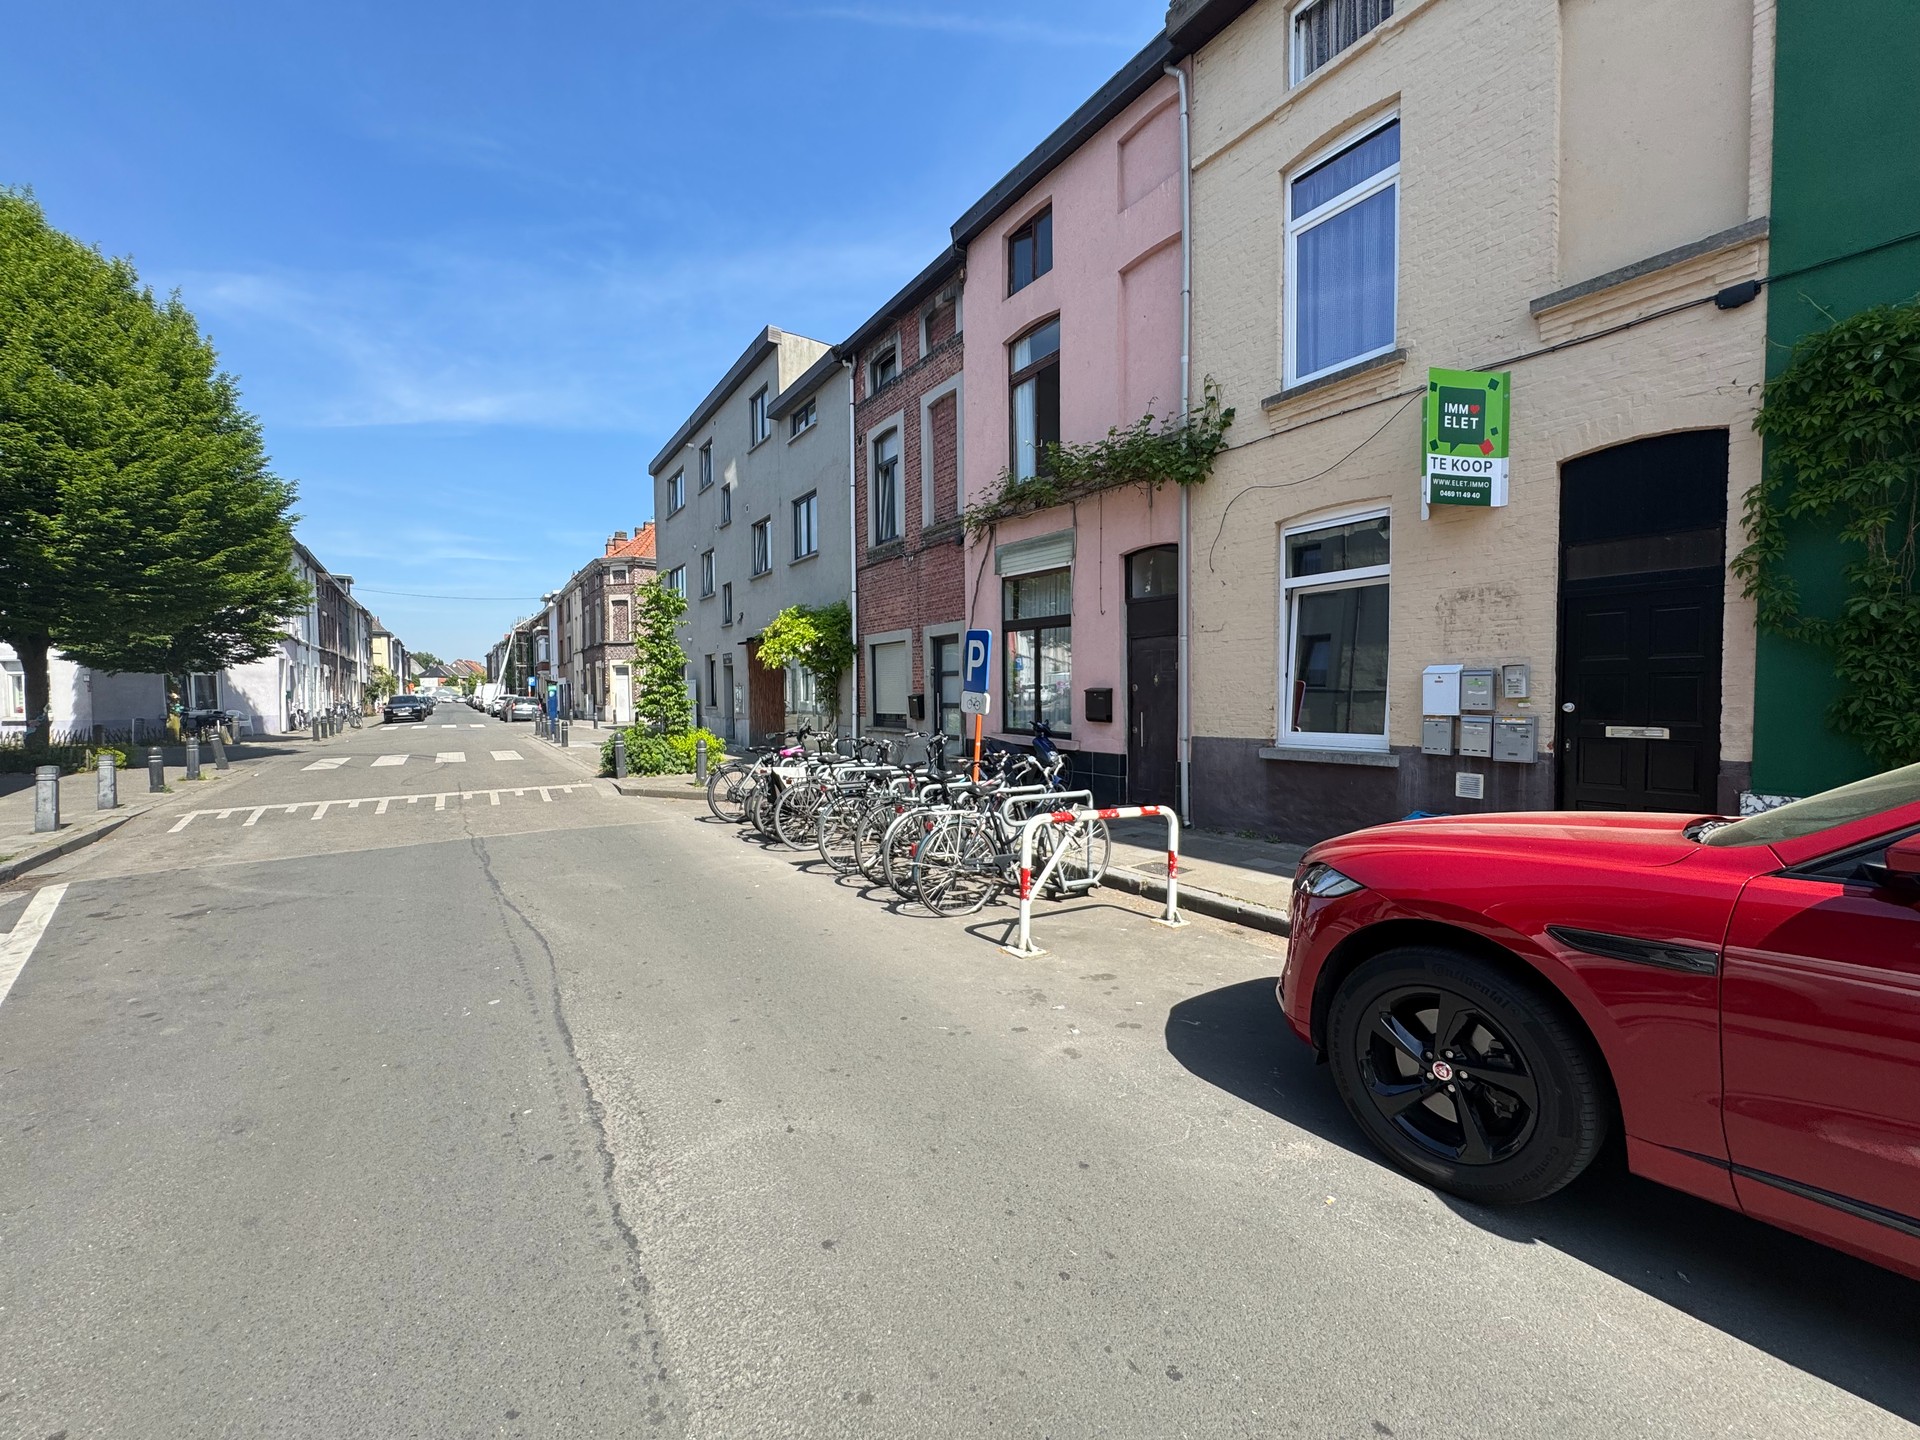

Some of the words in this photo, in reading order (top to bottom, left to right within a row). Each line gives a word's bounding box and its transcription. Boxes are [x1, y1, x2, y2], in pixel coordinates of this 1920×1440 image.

[1444, 416, 1479, 429] ELET
[1431, 457, 1447, 470] TE
[1451, 459, 1493, 472] KOOP
[1432, 478, 1490, 488] WWW.ELET.IMMO
[967, 640, 985, 681] P
